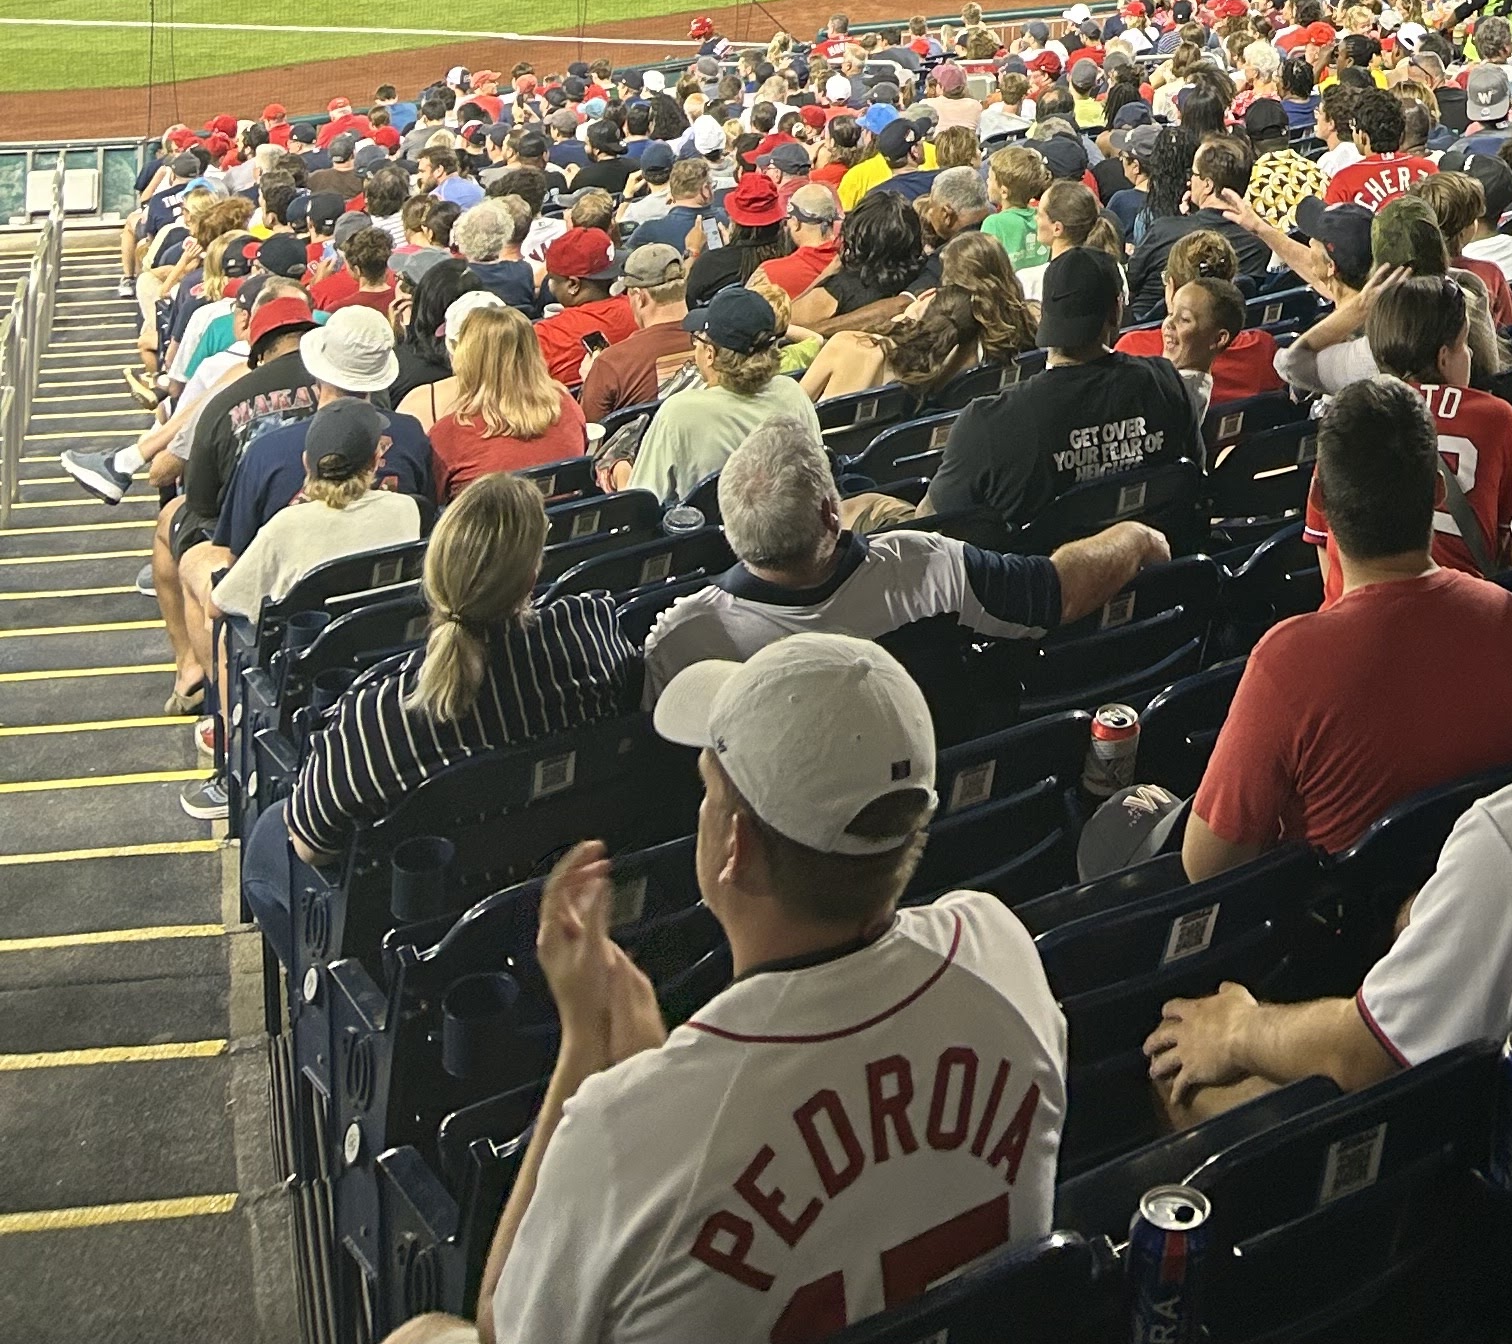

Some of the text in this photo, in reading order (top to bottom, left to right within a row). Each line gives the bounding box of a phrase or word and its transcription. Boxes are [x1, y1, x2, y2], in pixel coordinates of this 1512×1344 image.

[1053, 430, 1164, 471] YOUR FEAR OF
[1069, 416, 1147, 449] GET OVER
[689, 1046, 1041, 1292] PEDROIA
